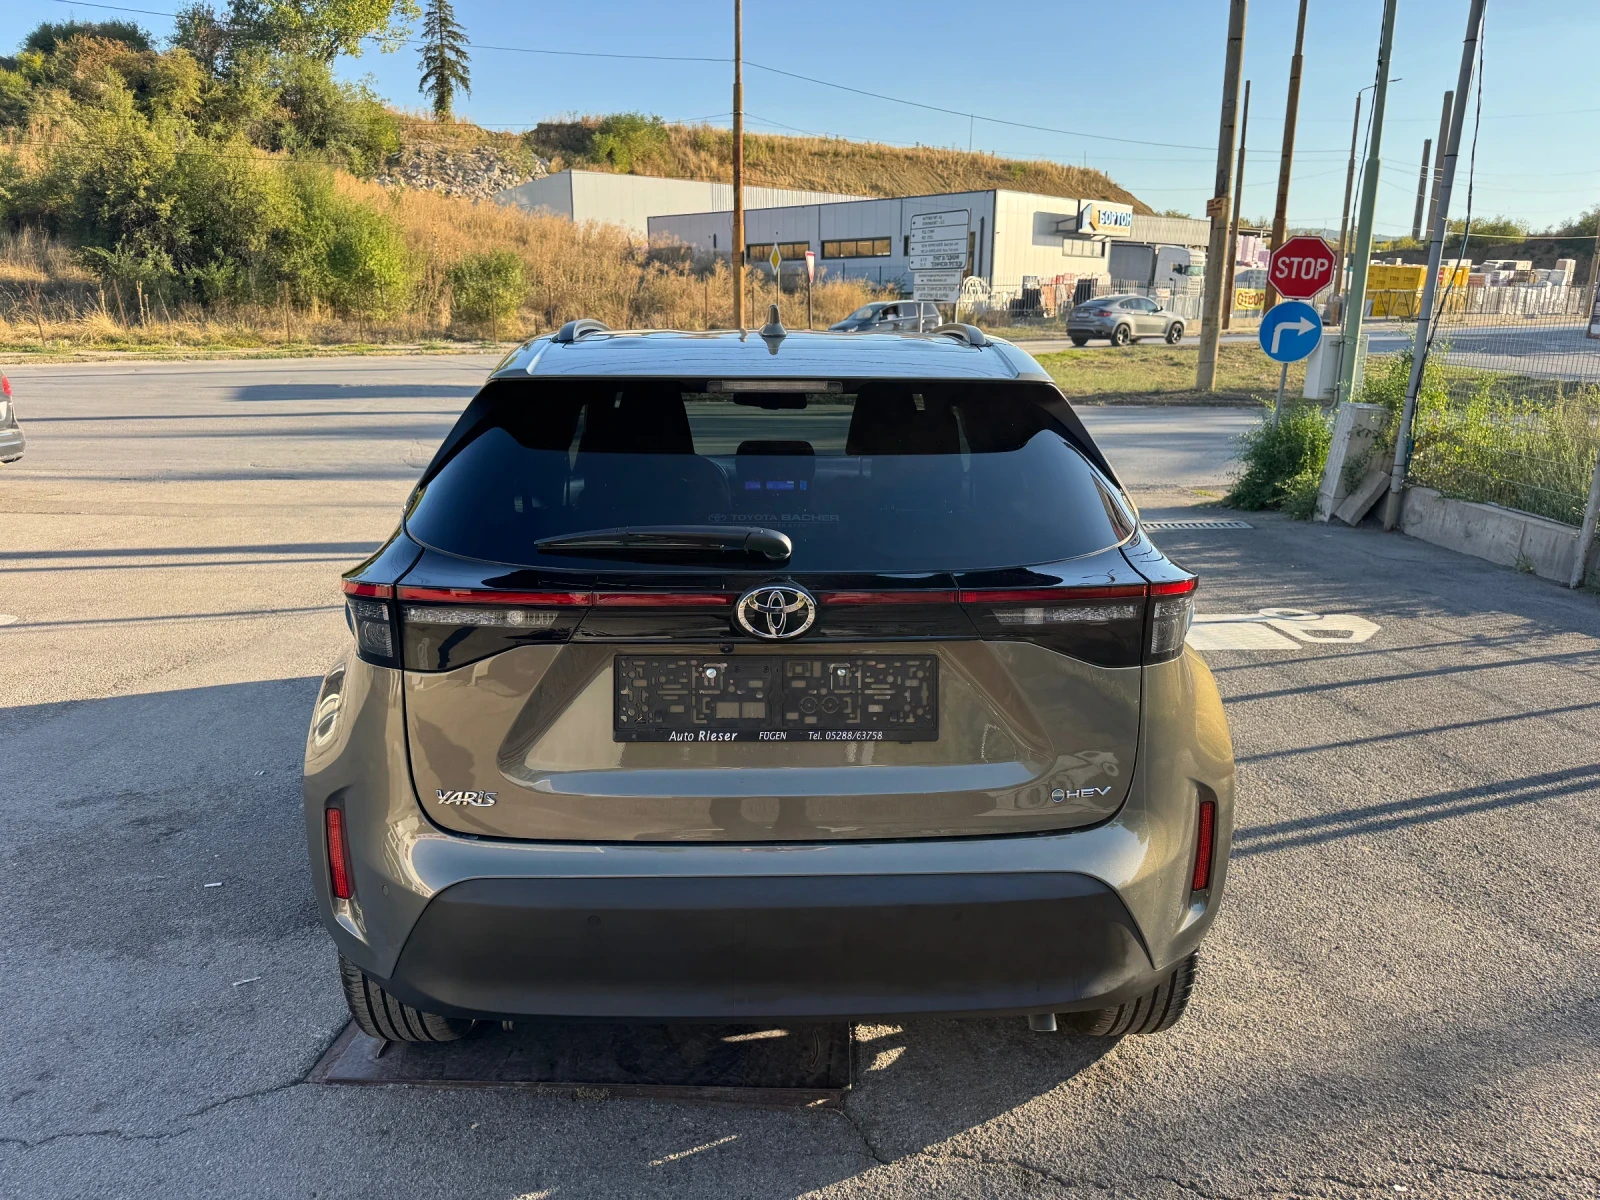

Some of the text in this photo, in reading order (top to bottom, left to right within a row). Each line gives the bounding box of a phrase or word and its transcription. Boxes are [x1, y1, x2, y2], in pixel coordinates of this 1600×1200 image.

[1098, 209, 1133, 227] БОРТОН
[1275, 256, 1329, 280] STOP
[781, 514, 840, 522] BACHER
[668, 731, 695, 742] Auto
[698, 730, 738, 742] Rieser
[808, 731, 823, 741] Tel.
[825, 731, 883, 741] 05288/63758
[1066, 786, 1112, 799] HEV
